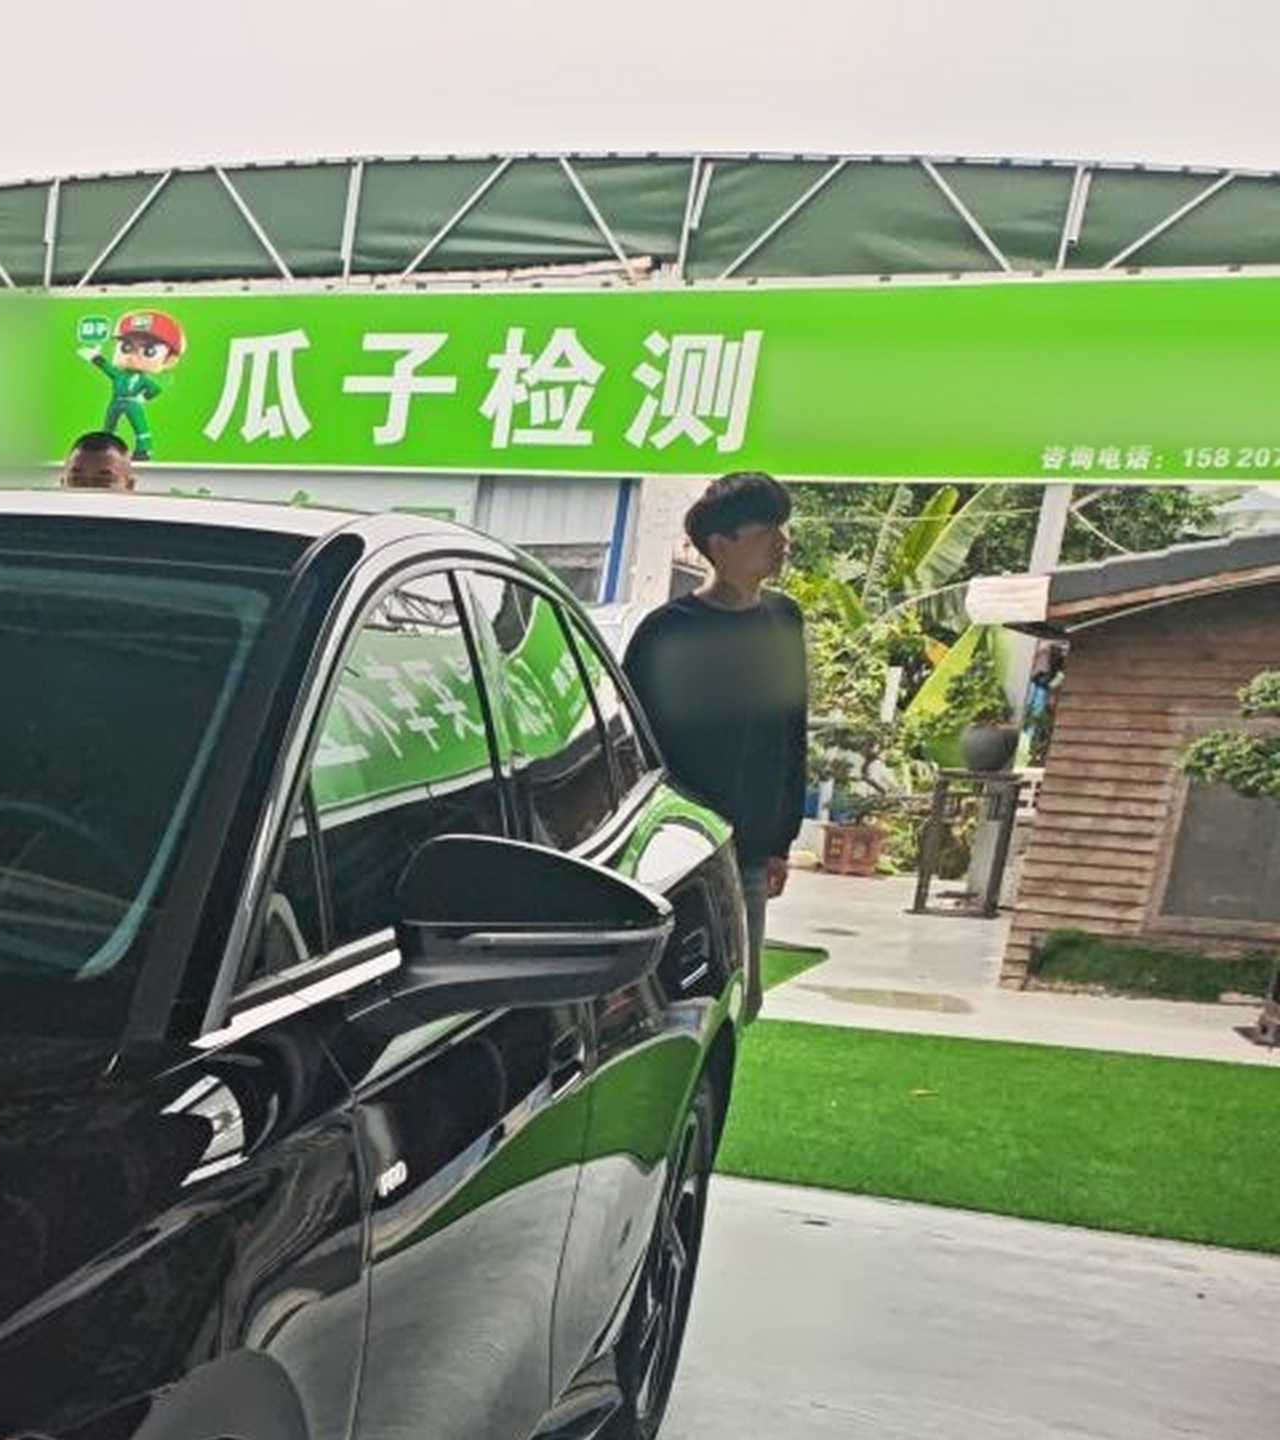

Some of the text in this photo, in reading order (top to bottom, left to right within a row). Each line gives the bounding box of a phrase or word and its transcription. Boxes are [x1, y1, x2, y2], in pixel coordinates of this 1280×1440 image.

[203, 327, 762, 453] 瓜子检测
[1183, 447, 1230, 468] 158
